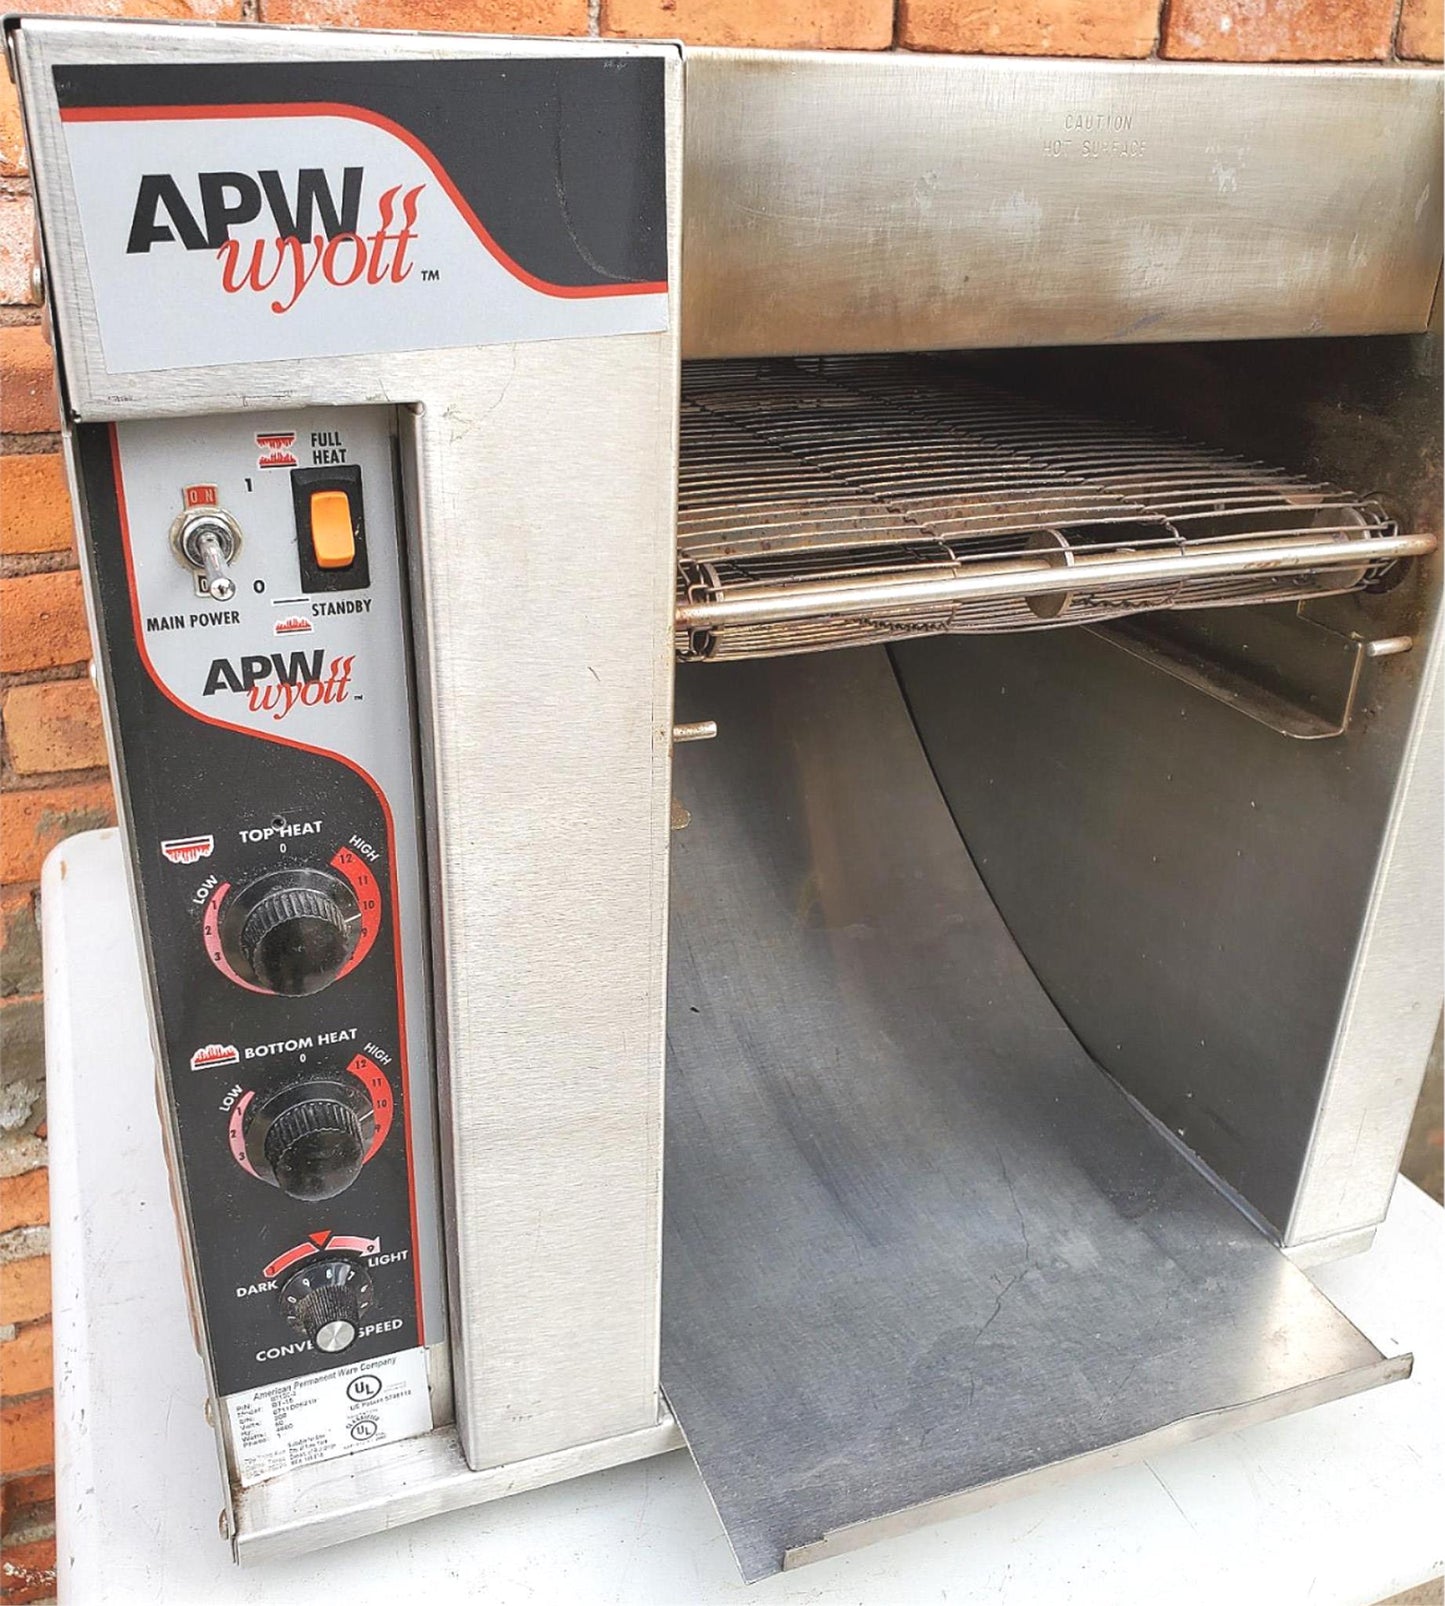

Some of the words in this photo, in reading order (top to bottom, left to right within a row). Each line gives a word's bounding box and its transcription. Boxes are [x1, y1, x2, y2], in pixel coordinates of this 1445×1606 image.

[1065, 114, 1133, 131] CAUTION
[1043, 140, 1072, 158] HOT
[126, 167, 364, 253] APW
[216, 184, 426, 314] wyott
[311, 432, 342, 447] FULL
[312, 449, 347, 465] HEAT
[190, 487, 215, 503] ON
[311, 599, 372, 617] STANDBY
[147, 614, 185, 632] MAIN
[190, 610, 240, 629] POWER
[203, 649, 325, 696] APW
[246, 655, 356, 720] wyott
[239, 828, 275, 844] TOP
[279, 820, 323, 838] HEAT
[349, 834, 380, 862] HIGH
[339, 853, 353, 864] 12
[192, 874, 218, 905] LOW
[358, 876, 369, 886] 11
[211, 901, 217, 911] 1
[363, 900, 375, 910] 10
[204, 926, 212, 936] 2
[214, 952, 221, 961] 3
[244, 1037, 314, 1060] BOTTOM
[318, 1028, 358, 1046] HEAT
[363, 1042, 392, 1066] HIGH
[354, 1059, 367, 1069] 12
[219, 1083, 243, 1113] LOW
[376, 1099, 387, 1108] 10
[236, 1106, 242, 1116] 1
[230, 1129, 237, 1139] 2
[239, 1152, 245, 1161] 3
[367, 1250, 409, 1268] LIGHT
[236, 1280, 279, 1298] DARK
[255, 1339, 314, 1362] CONVE
[358, 1319, 404, 1338] SPEED
[253, 1385, 292, 1401] American
[294, 1371, 337, 1390] Permanent
[338, 1366, 359, 1377] Ware
[360, 1357, 397, 1371] Company
[354, 1381, 375, 1395] UL
[356, 1425, 371, 1436] UL
